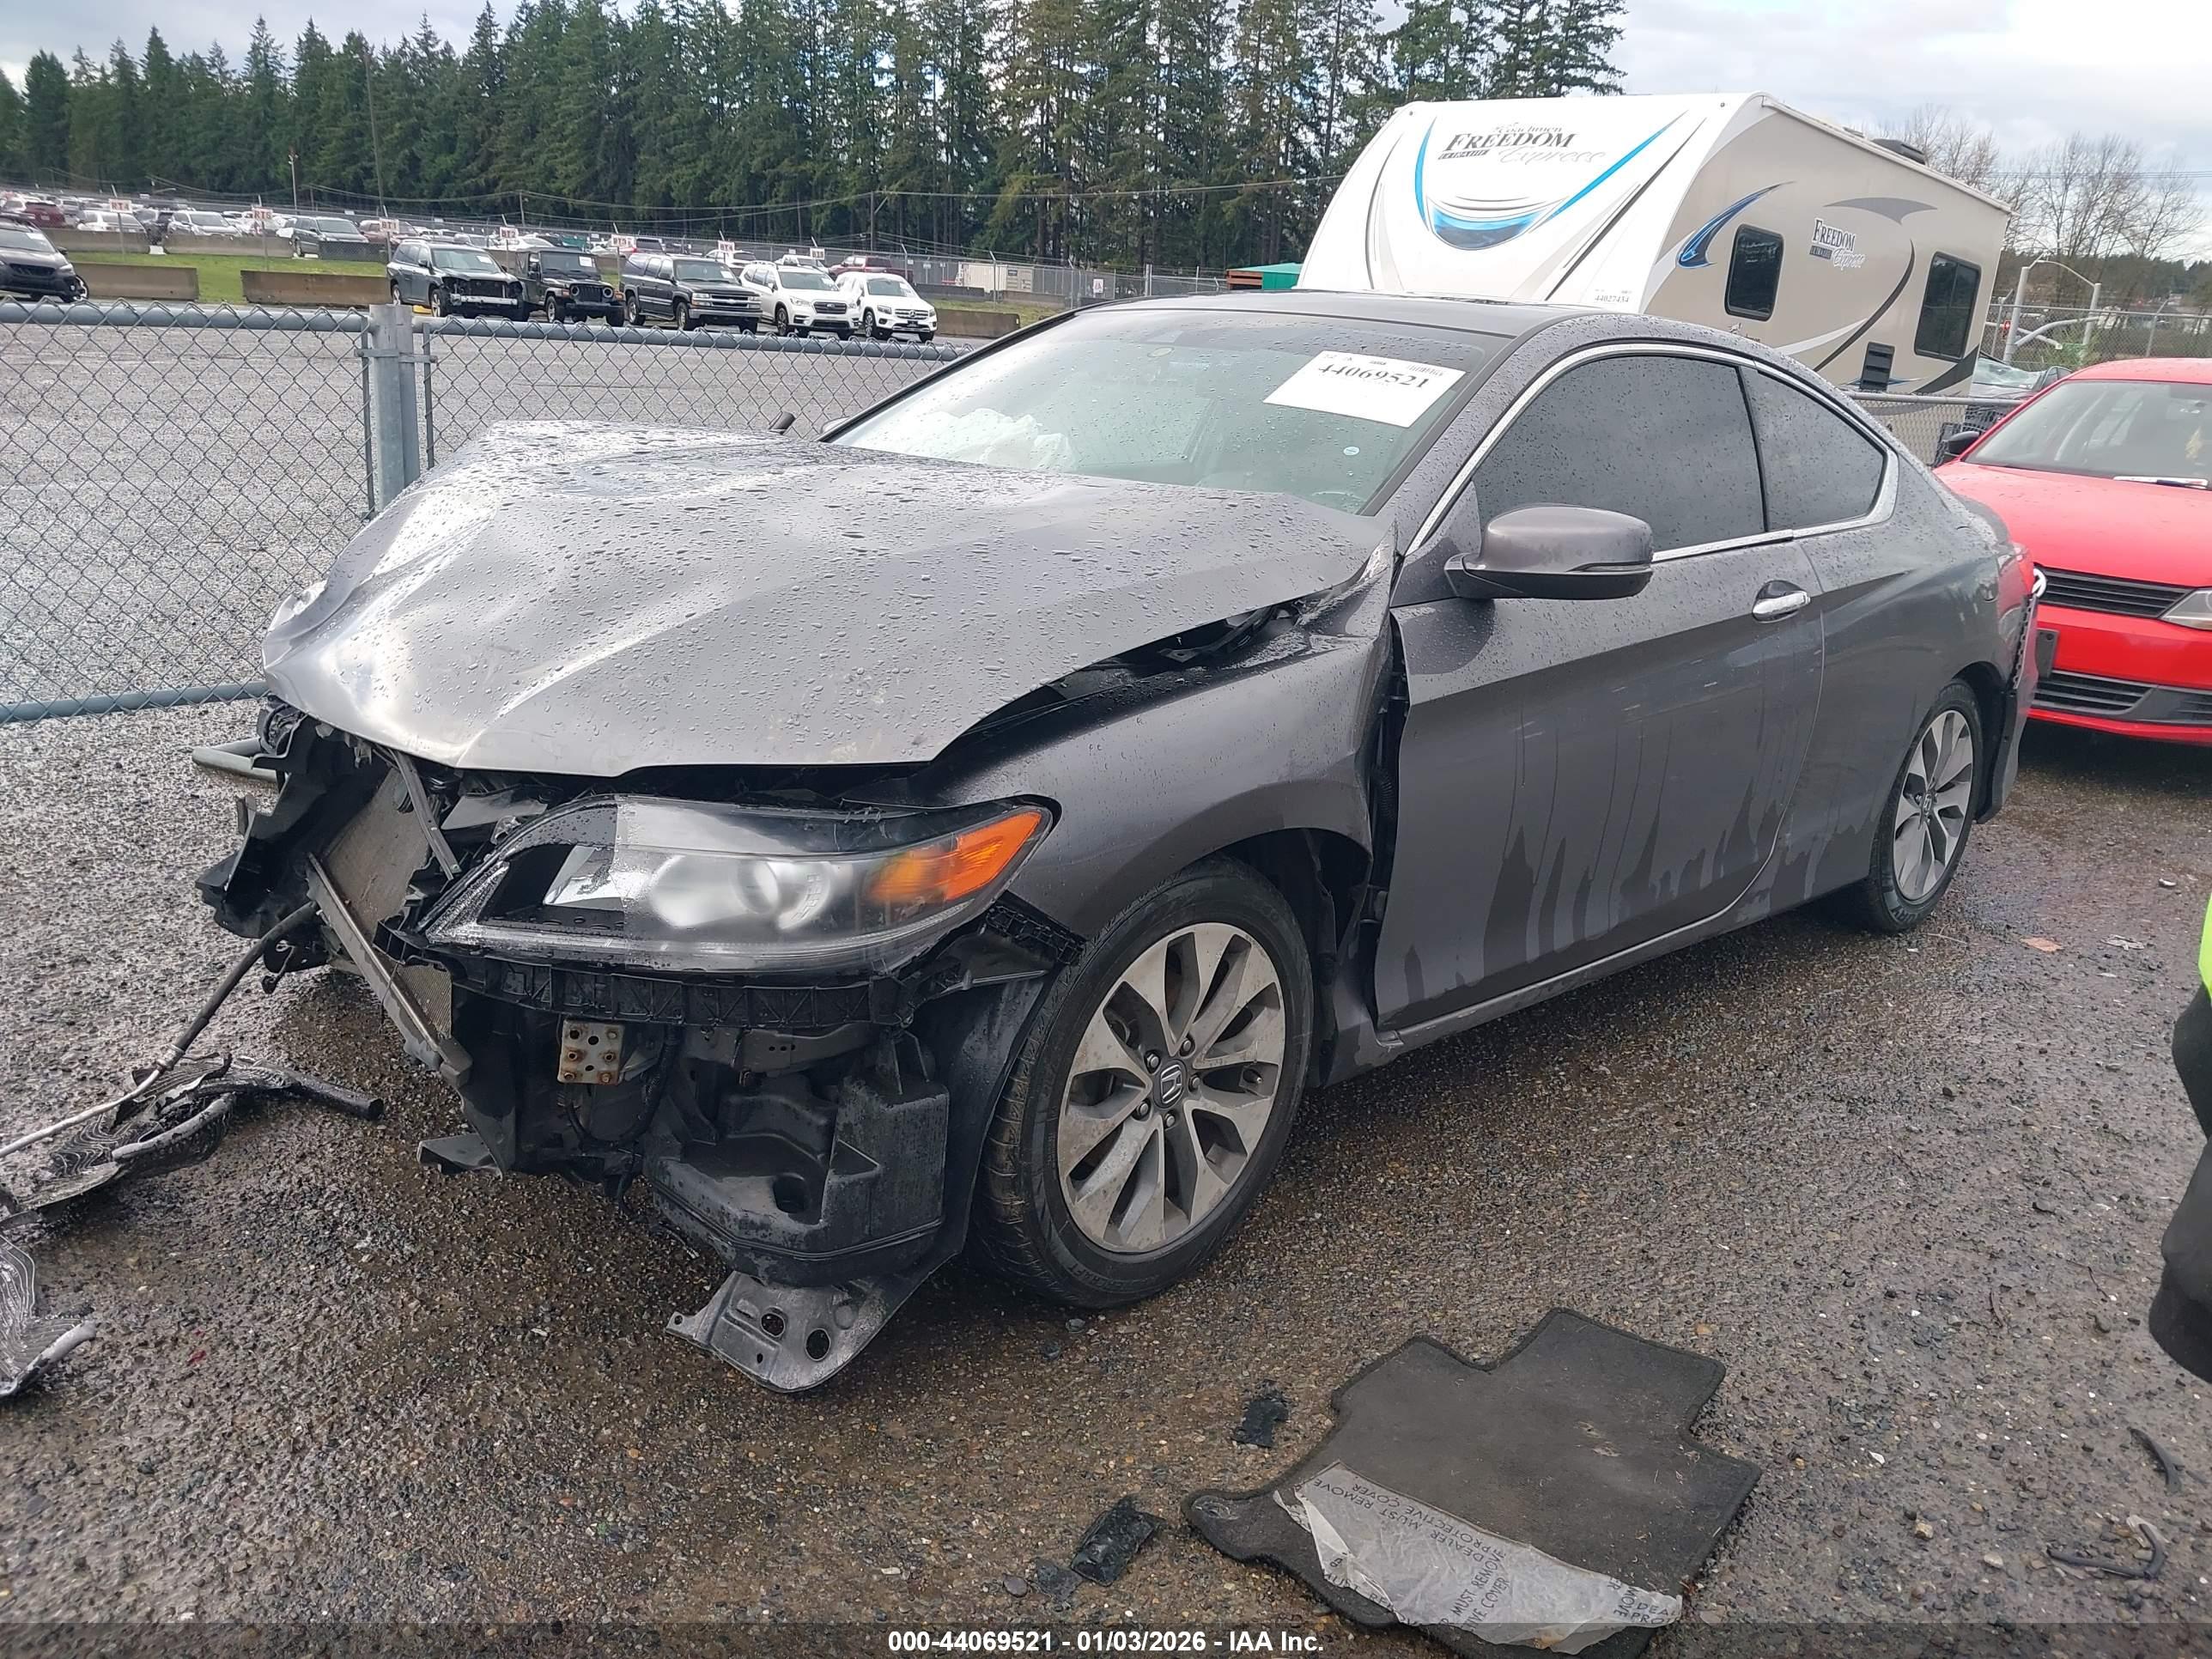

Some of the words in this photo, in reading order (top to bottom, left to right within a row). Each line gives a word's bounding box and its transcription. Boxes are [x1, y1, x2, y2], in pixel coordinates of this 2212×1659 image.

[1443, 132, 1578, 152] FREEDOM
[1498, 146, 1606, 165] Express
[1812, 218, 1856, 252] FREEDOM
[1833, 248, 1866, 271] Express
[1319, 364, 1430, 388] 44069521
[1313, 1478, 1374, 1510] REMOVE
[1352, 1483, 1400, 1508] COVER
[1379, 1508, 1422, 1529] MUST
[1407, 1505, 1492, 1553] PROTECTIVE
[1430, 1529, 1484, 1562] DEALER
[1450, 1589, 1477, 1616] MUST
[1481, 1577, 1510, 1607] COVER
